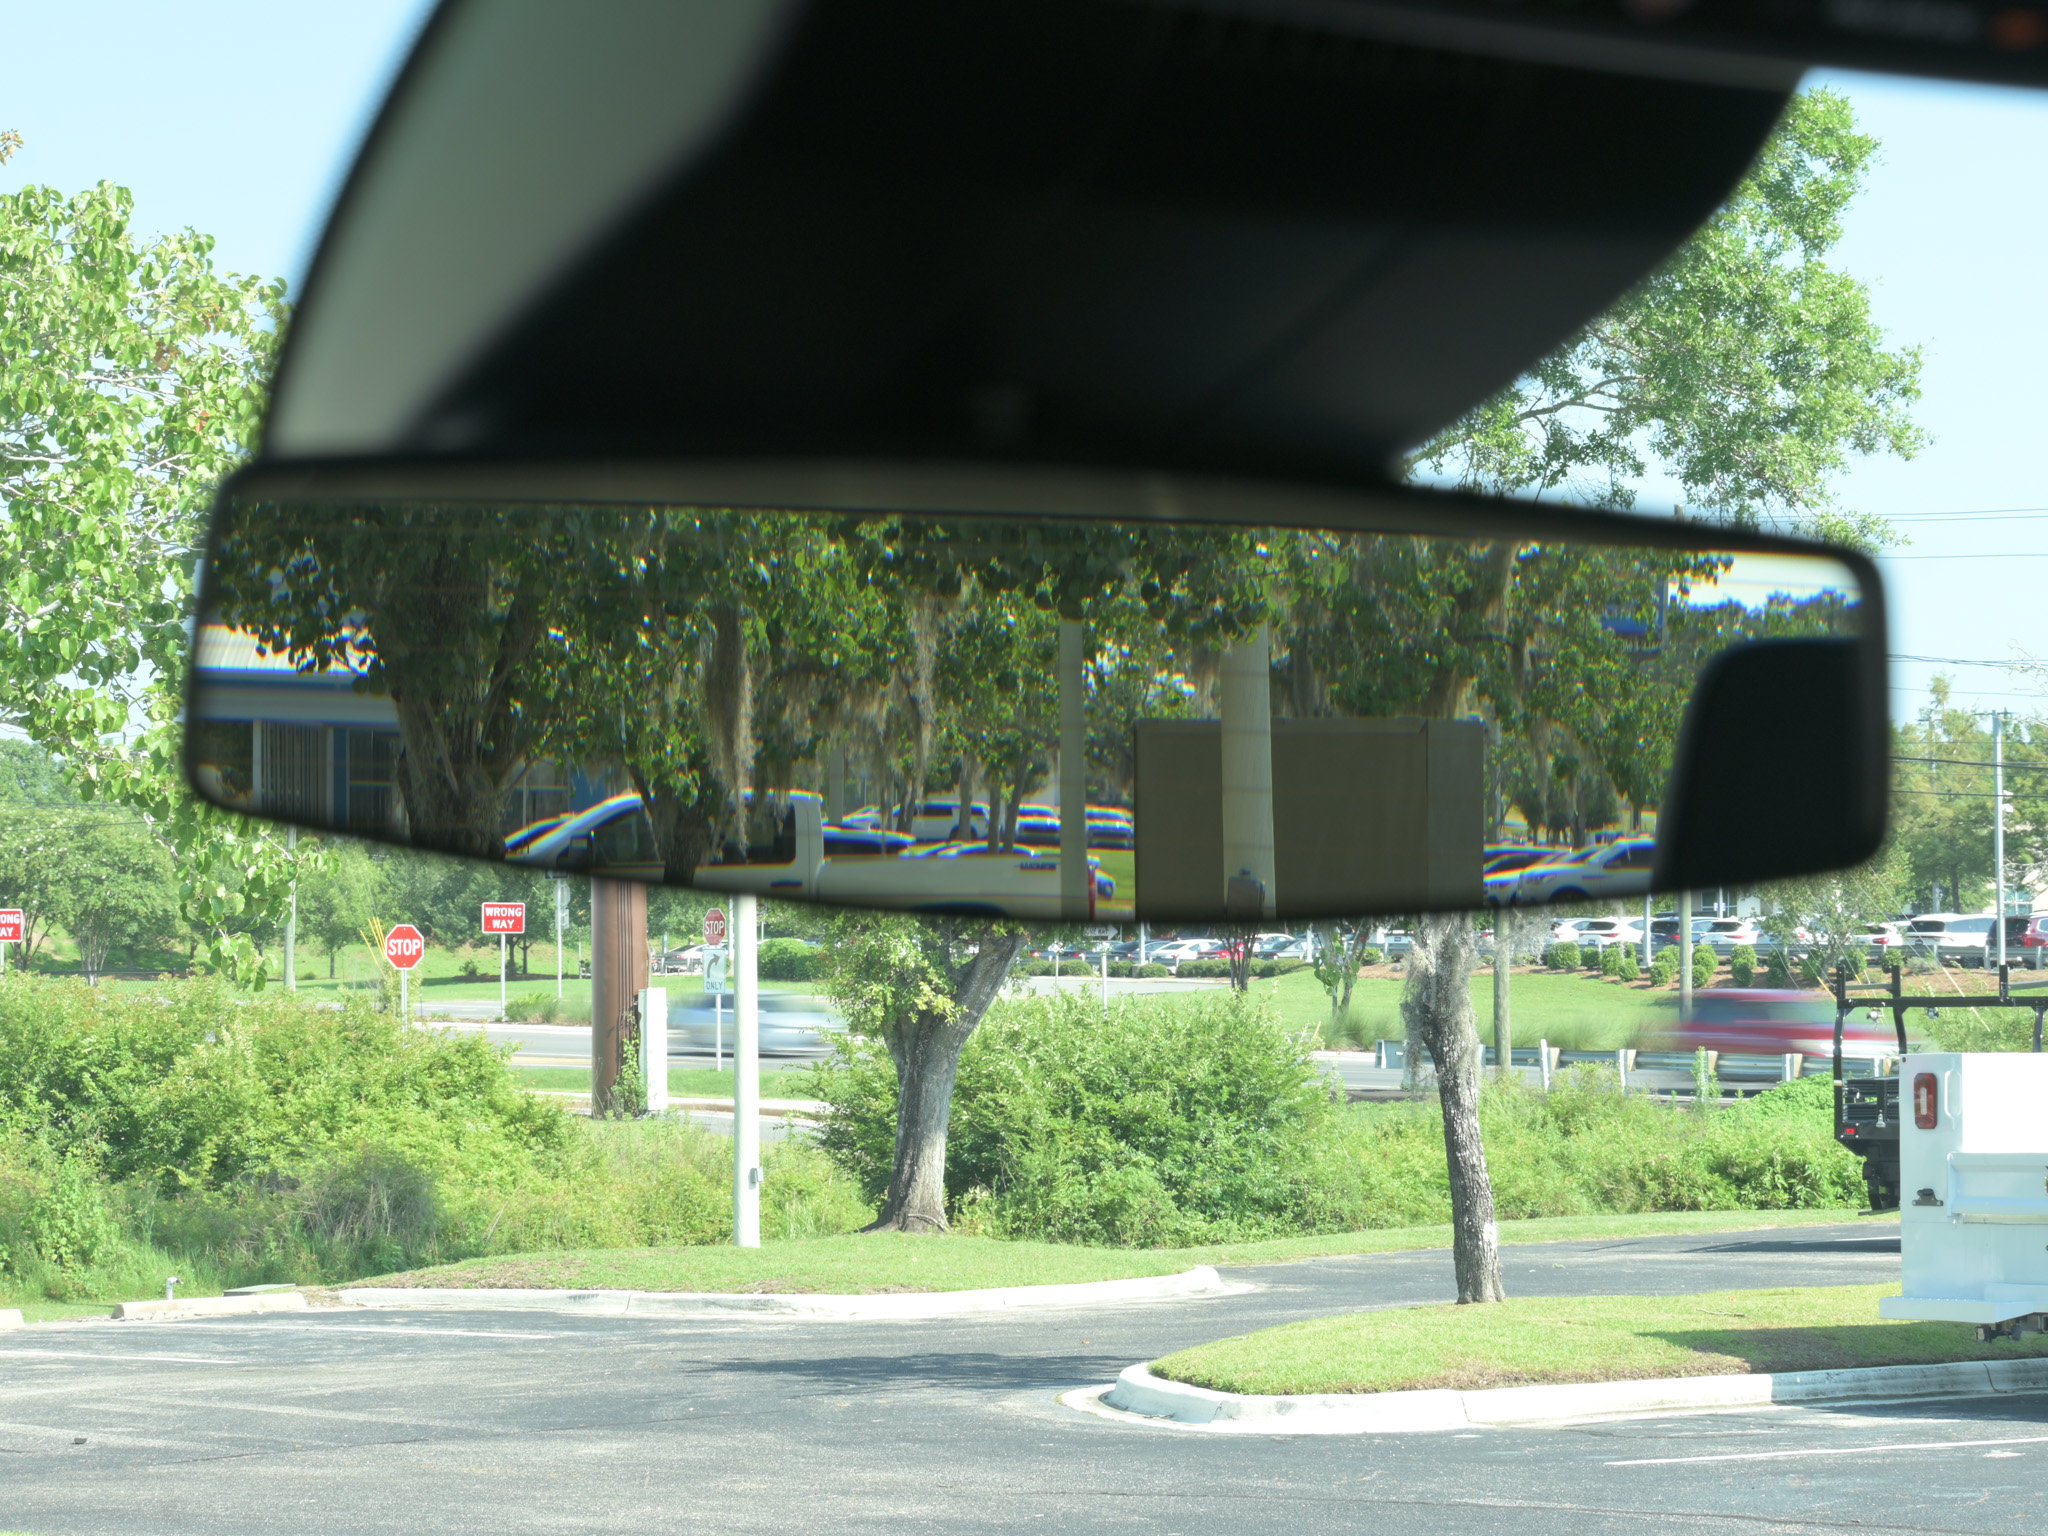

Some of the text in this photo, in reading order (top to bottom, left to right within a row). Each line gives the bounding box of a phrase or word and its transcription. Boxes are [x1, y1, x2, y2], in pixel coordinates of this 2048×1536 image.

[485, 907, 522, 917] WRONG
[0, 913, 20, 924] ONG
[492, 919, 515, 929] WAY
[0, 926, 14, 937] AY
[704, 920, 725, 935] STOP
[388, 938, 421, 956] STOP
[706, 981, 723, 990] ONLY
